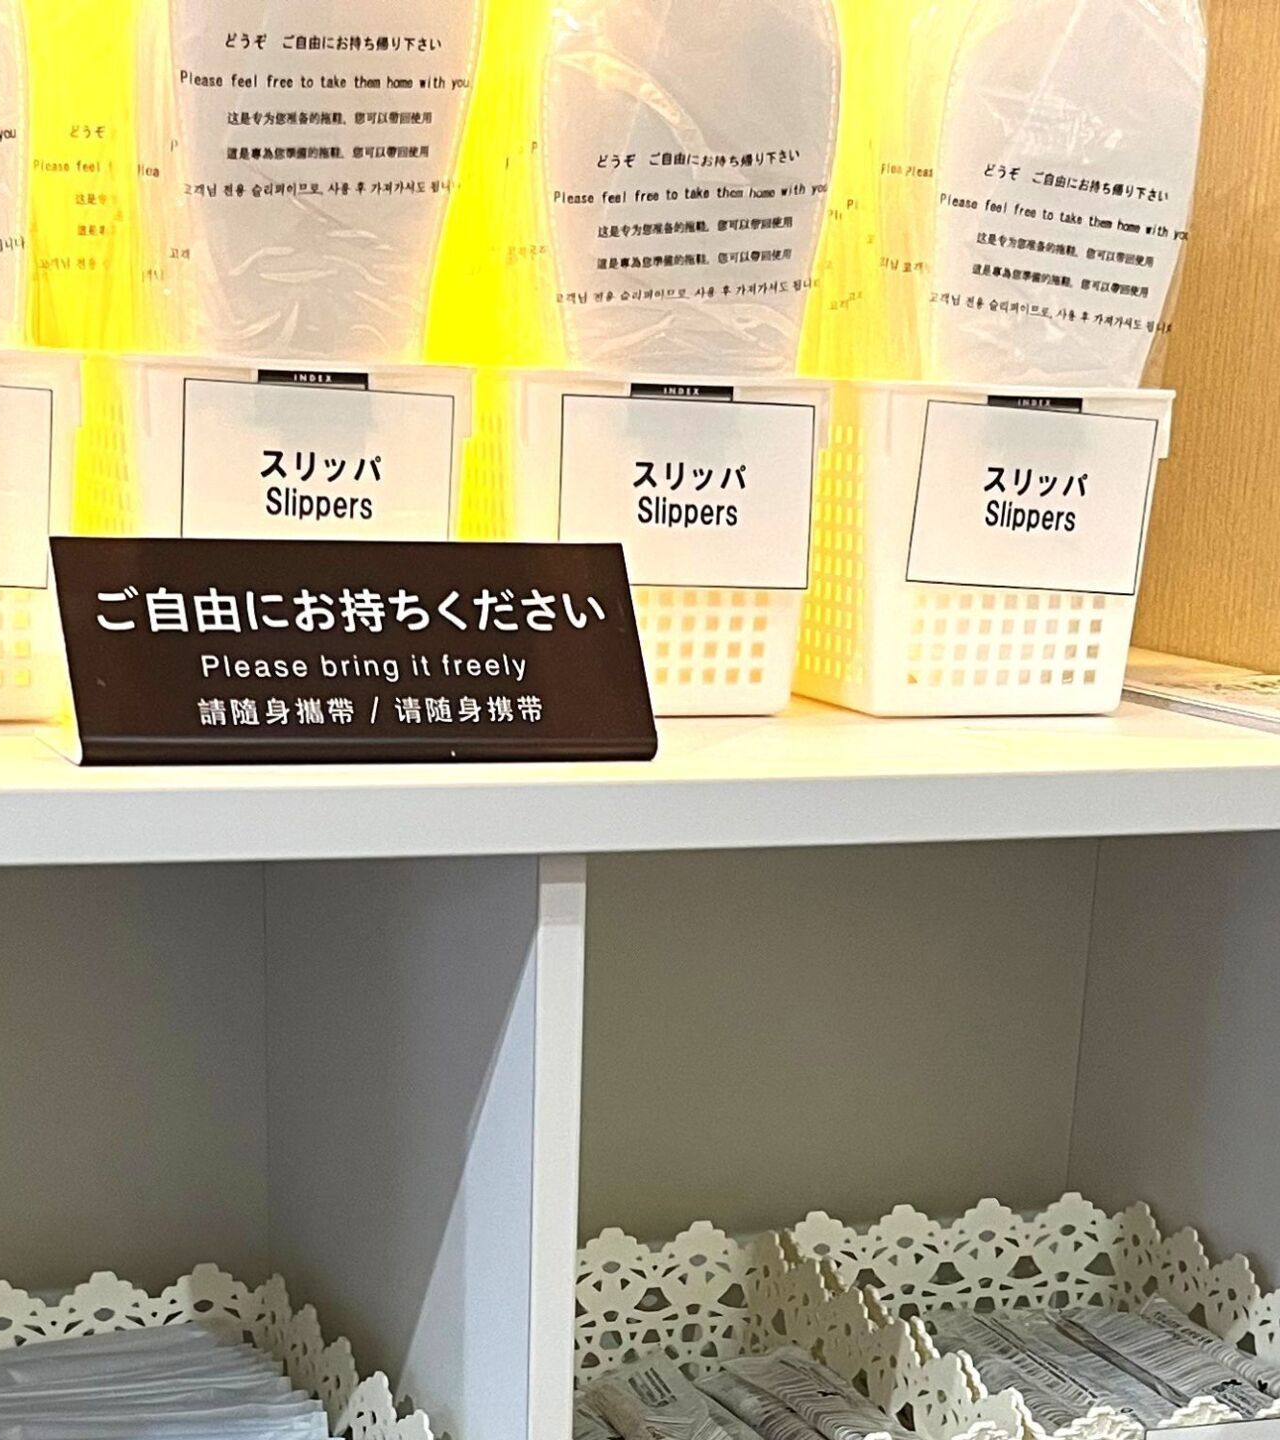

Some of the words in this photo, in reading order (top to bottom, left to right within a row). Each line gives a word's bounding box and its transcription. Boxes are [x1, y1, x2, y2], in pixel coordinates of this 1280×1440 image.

[226, 33, 267, 50] どうぞ
[282, 33, 442, 51] ご自由にお持ち帰り下さい
[180, 70, 222, 86] Please
[232, 74, 257, 88] feel
[267, 75, 293, 88] free
[301, 75, 313, 88] to
[321, 75, 346, 88] take
[355, 76, 380, 88] them
[387, 76, 412, 88] home
[420, 76, 445, 88] with
[70, 125, 105, 138] どうぞ
[597, 154, 636, 168] どうぞ
[984, 164, 1020, 181] どうぞ
[554, 191, 594, 204] Please
[602, 191, 626, 203] feel
[635, 190, 659, 201] free
[666, 189, 678, 200] to
[685, 187, 709, 199] take
[717, 187, 743, 198] them
[749, 188, 775, 198] home
[781, 184, 806, 196] with
[940, 193, 977, 210] Please
[985, 199, 1006, 214] feel
[1014, 203, 1036, 218] free
[1043, 209, 1053, 221] to
[1060, 212, 1082, 225] take
[1089, 216, 1112, 228] them
[1118, 218, 1140, 233] home
[1146, 224, 1168, 237] with
[293, 374, 333, 383] INDEX
[663, 386, 701, 397] INDEX
[260, 448, 382, 483] スリッパ
[633, 461, 747, 492] スリッパ
[984, 466, 1088, 498] スリッパ
[265, 486, 373, 521] Slippers
[637, 497, 738, 528] Slippers
[984, 501, 1077, 532] Slippers
[95, 585, 607, 634] ご自由にお持ちください
[201, 655, 307, 679] Please
[321, 654, 399, 682] bring
[413, 654, 431, 677] it
[443, 653, 528, 681] freely
[395, 696, 543, 724] 请随身携带
